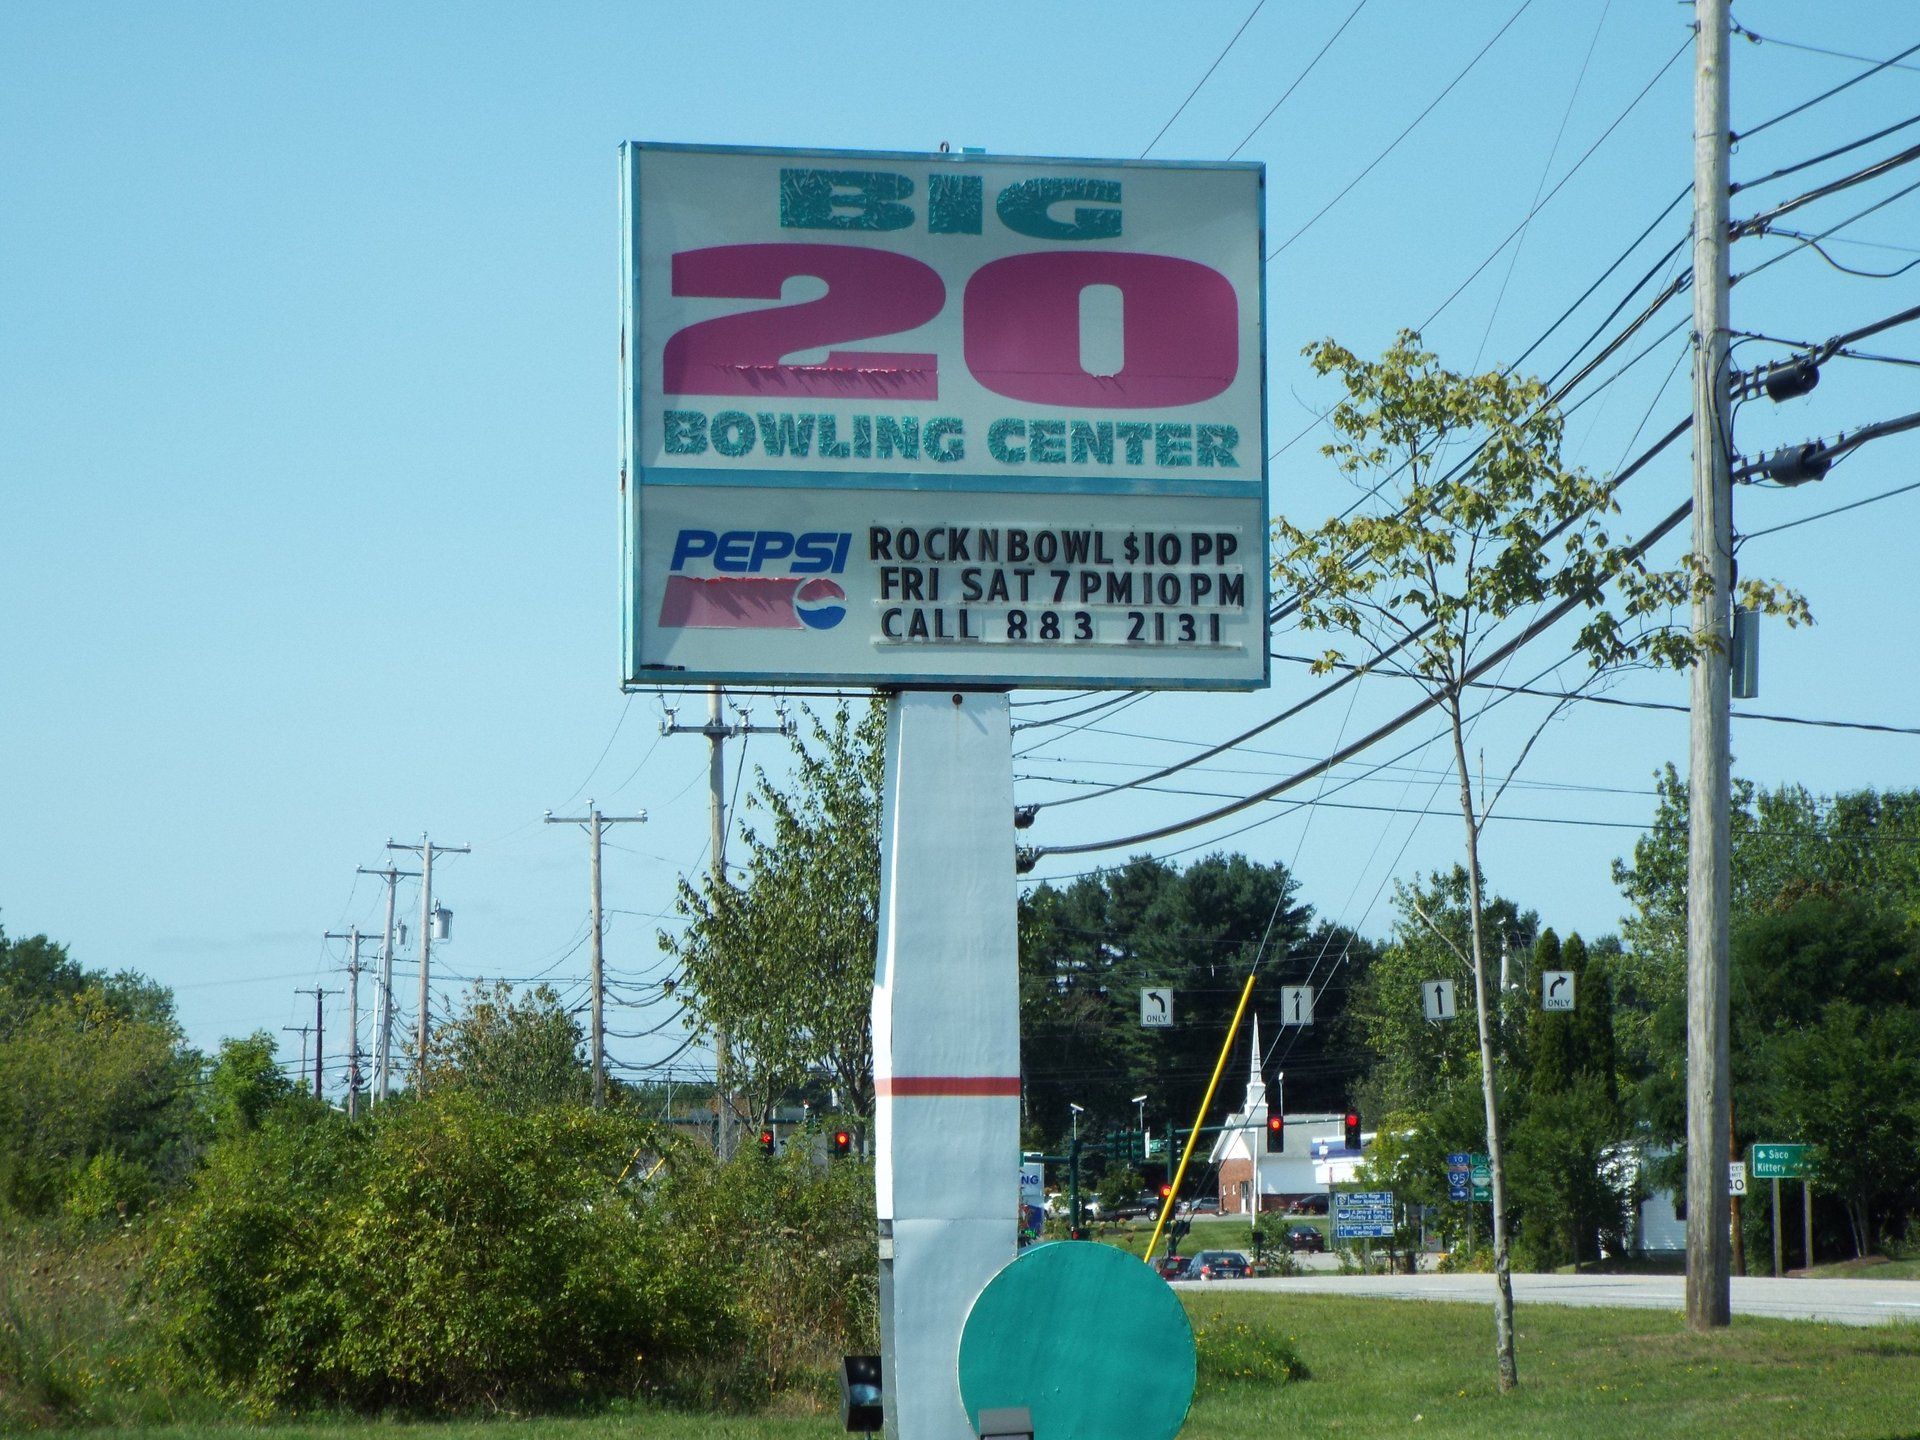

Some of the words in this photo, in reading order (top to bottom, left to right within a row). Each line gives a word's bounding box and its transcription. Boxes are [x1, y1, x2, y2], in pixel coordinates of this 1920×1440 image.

[780, 168, 1122, 240] BIG
[663, 243, 1239, 408] 20
[664, 410, 965, 464] BOWLING
[988, 418, 1240, 468] CENTER
[670, 529, 852, 574] PEPSI
[880, 566, 940, 601] FRI
[961, 568, 1035, 602] SAT
[881, 607, 979, 640] CALL
[1007, 609, 1094, 640] 883
[1126, 611, 1220, 642] 2131
[1547, 999, 1571, 1008] ONLY
[1146, 1014, 1168, 1023] ONLY
[1453, 1155, 1464, 1163] TO
[1768, 1149, 1789, 1160] Saco
[1452, 1173, 1466, 1184] 95
[1757, 1163, 1787, 1174] Kittery
